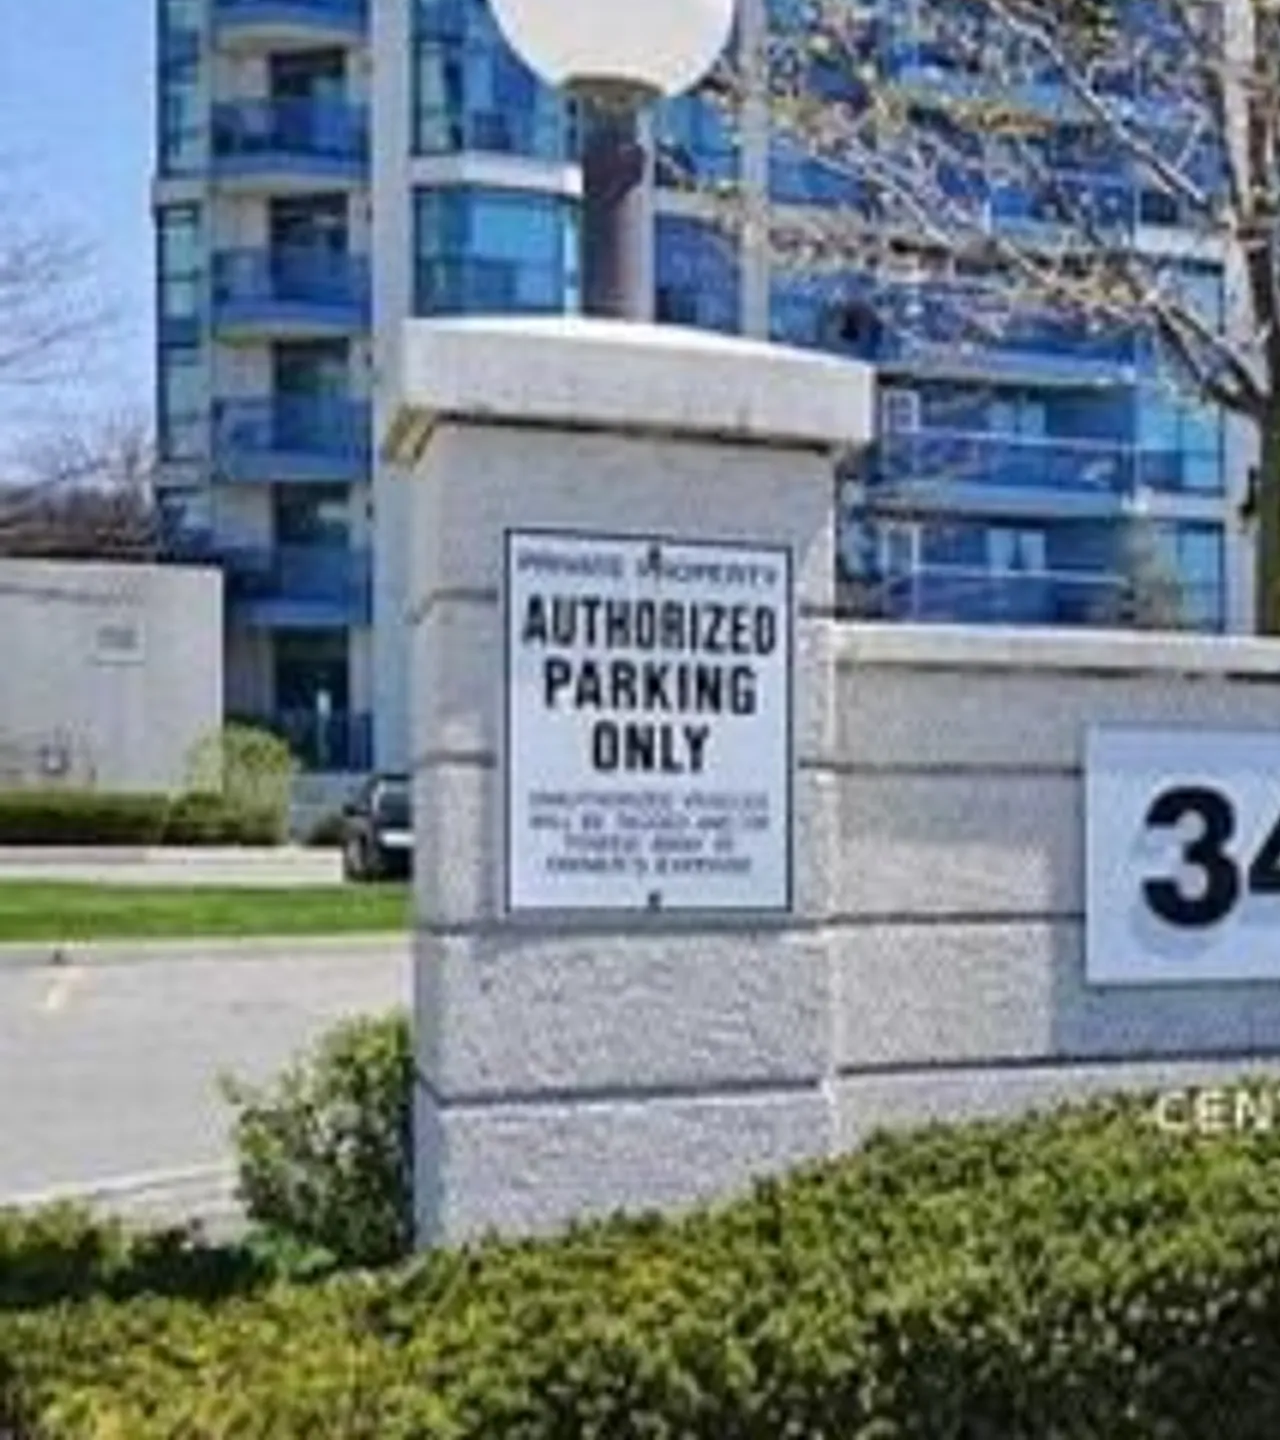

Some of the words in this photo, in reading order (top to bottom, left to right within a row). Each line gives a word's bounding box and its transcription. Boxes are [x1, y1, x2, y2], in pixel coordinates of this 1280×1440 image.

[522, 593, 776, 656] AUTHORIZED
[543, 658, 757, 715] PARKING
[592, 719, 710, 773] ONLY
